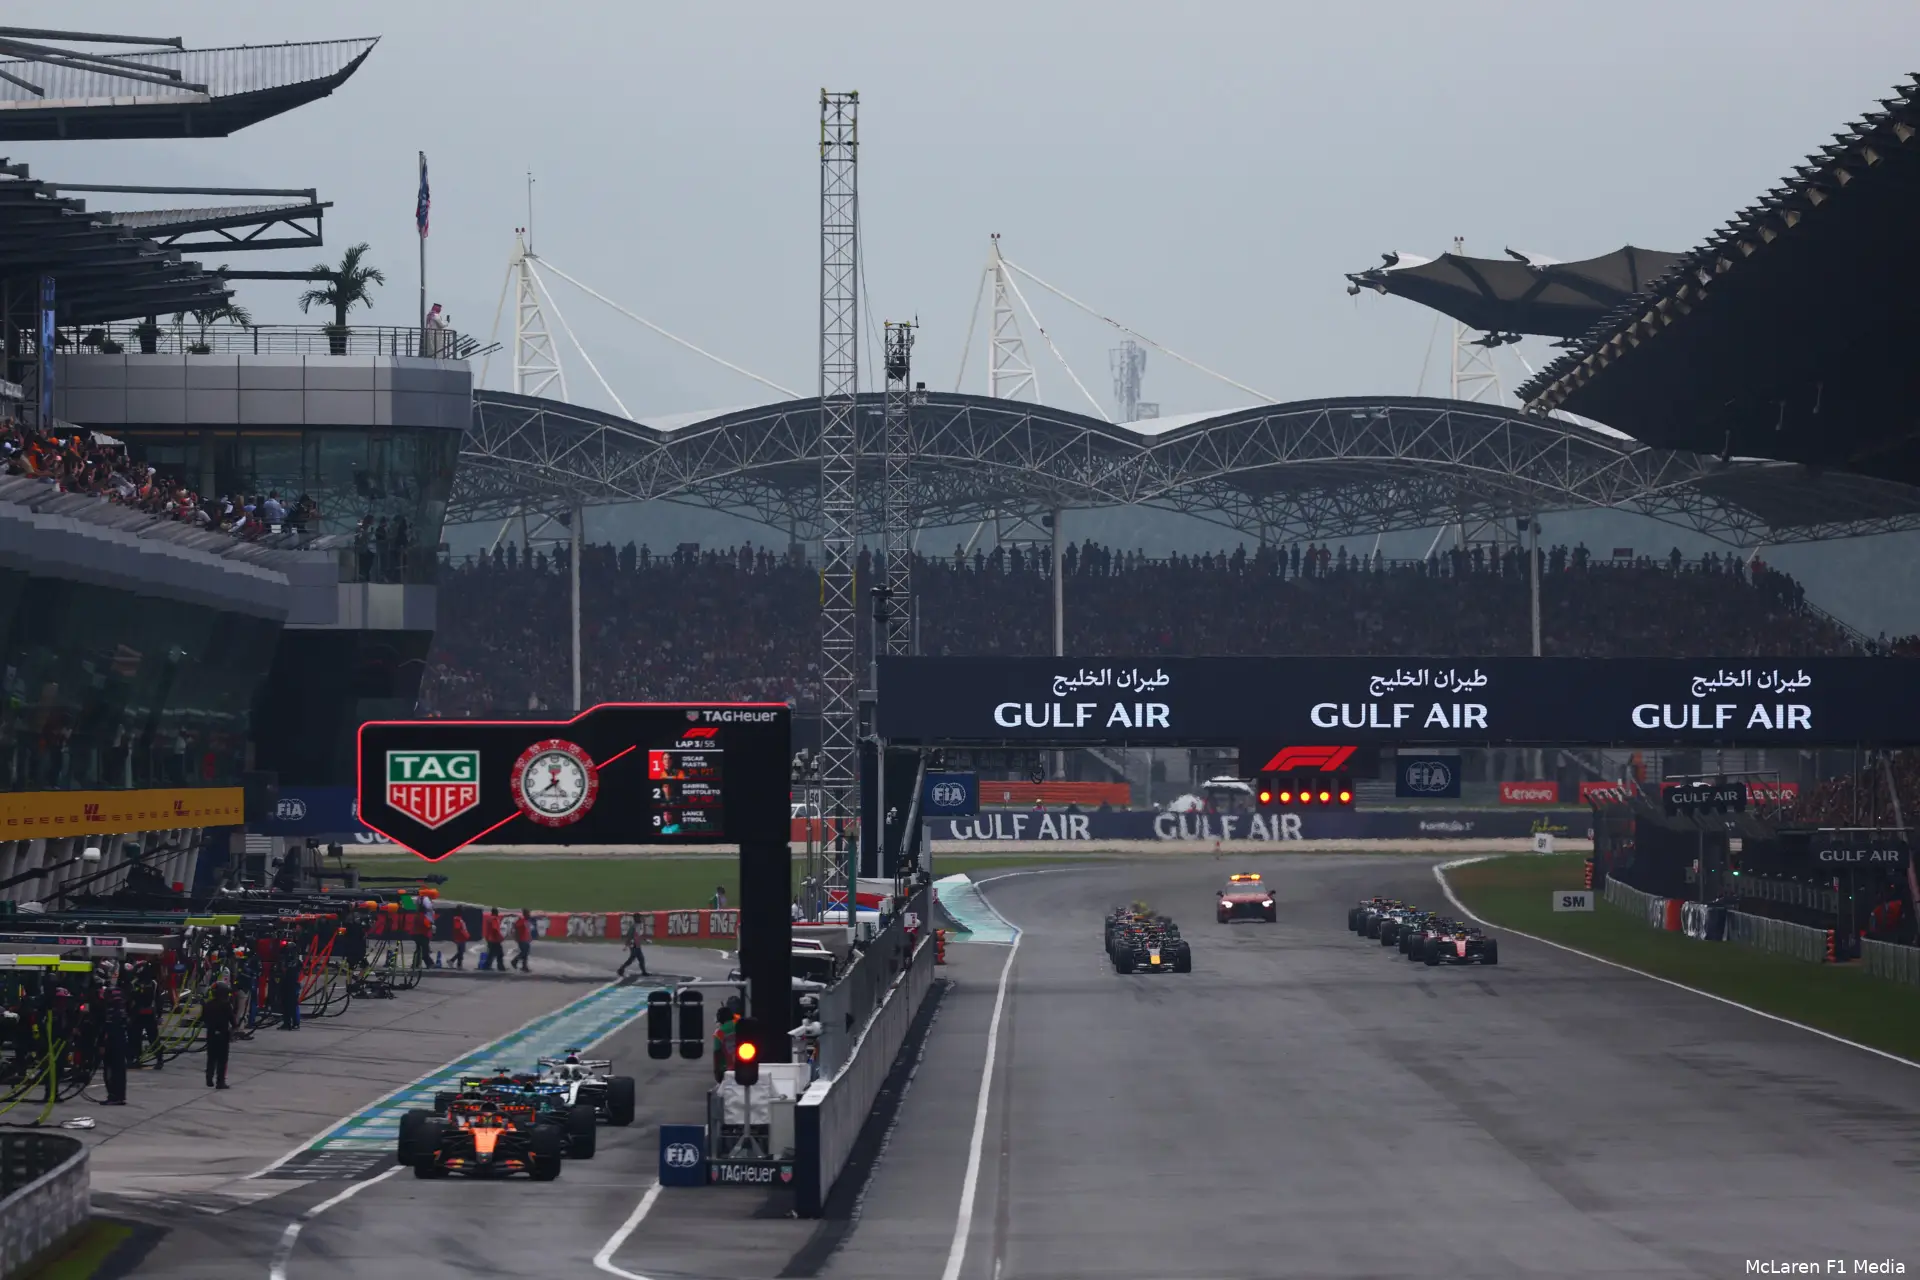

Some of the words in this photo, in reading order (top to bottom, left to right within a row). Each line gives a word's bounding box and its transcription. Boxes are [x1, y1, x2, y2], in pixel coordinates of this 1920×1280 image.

[1053, 668, 1112, 696] الخليج
[1116, 668, 1170, 692] طيران
[1370, 669, 1428, 696] الخليج
[1434, 669, 1488, 693] طيران
[1692, 670, 1751, 698] الخليج
[1757, 670, 1812, 694] طيران
[994, 702, 1097, 728] GULF
[1106, 702, 1170, 728] AIR
[1310, 703, 1414, 728] GULF
[1424, 703, 1488, 728] AIR
[1632, 704, 1737, 728] GULF
[1746, 704, 1812, 730] AIR
[394, 756, 470, 778] TAG
[653, 760, 660, 771] 1
[392, 787, 474, 822] HEUER
[652, 788, 660, 798] 2
[1504, 786, 1552, 800] Lenovo
[1672, 792, 1708, 803] GULF
[1714, 791, 1738, 801] AIR
[652, 816, 660, 826] 3
[951, 814, 1029, 840] GULF
[1038, 814, 1090, 840] AIR
[1154, 812, 1239, 840] GULF
[1250, 813, 1302, 841] AIR
[1820, 850, 1866, 862] GULF
[1870, 850, 1899, 861] AIR
[1562, 896, 1584, 908] SM
